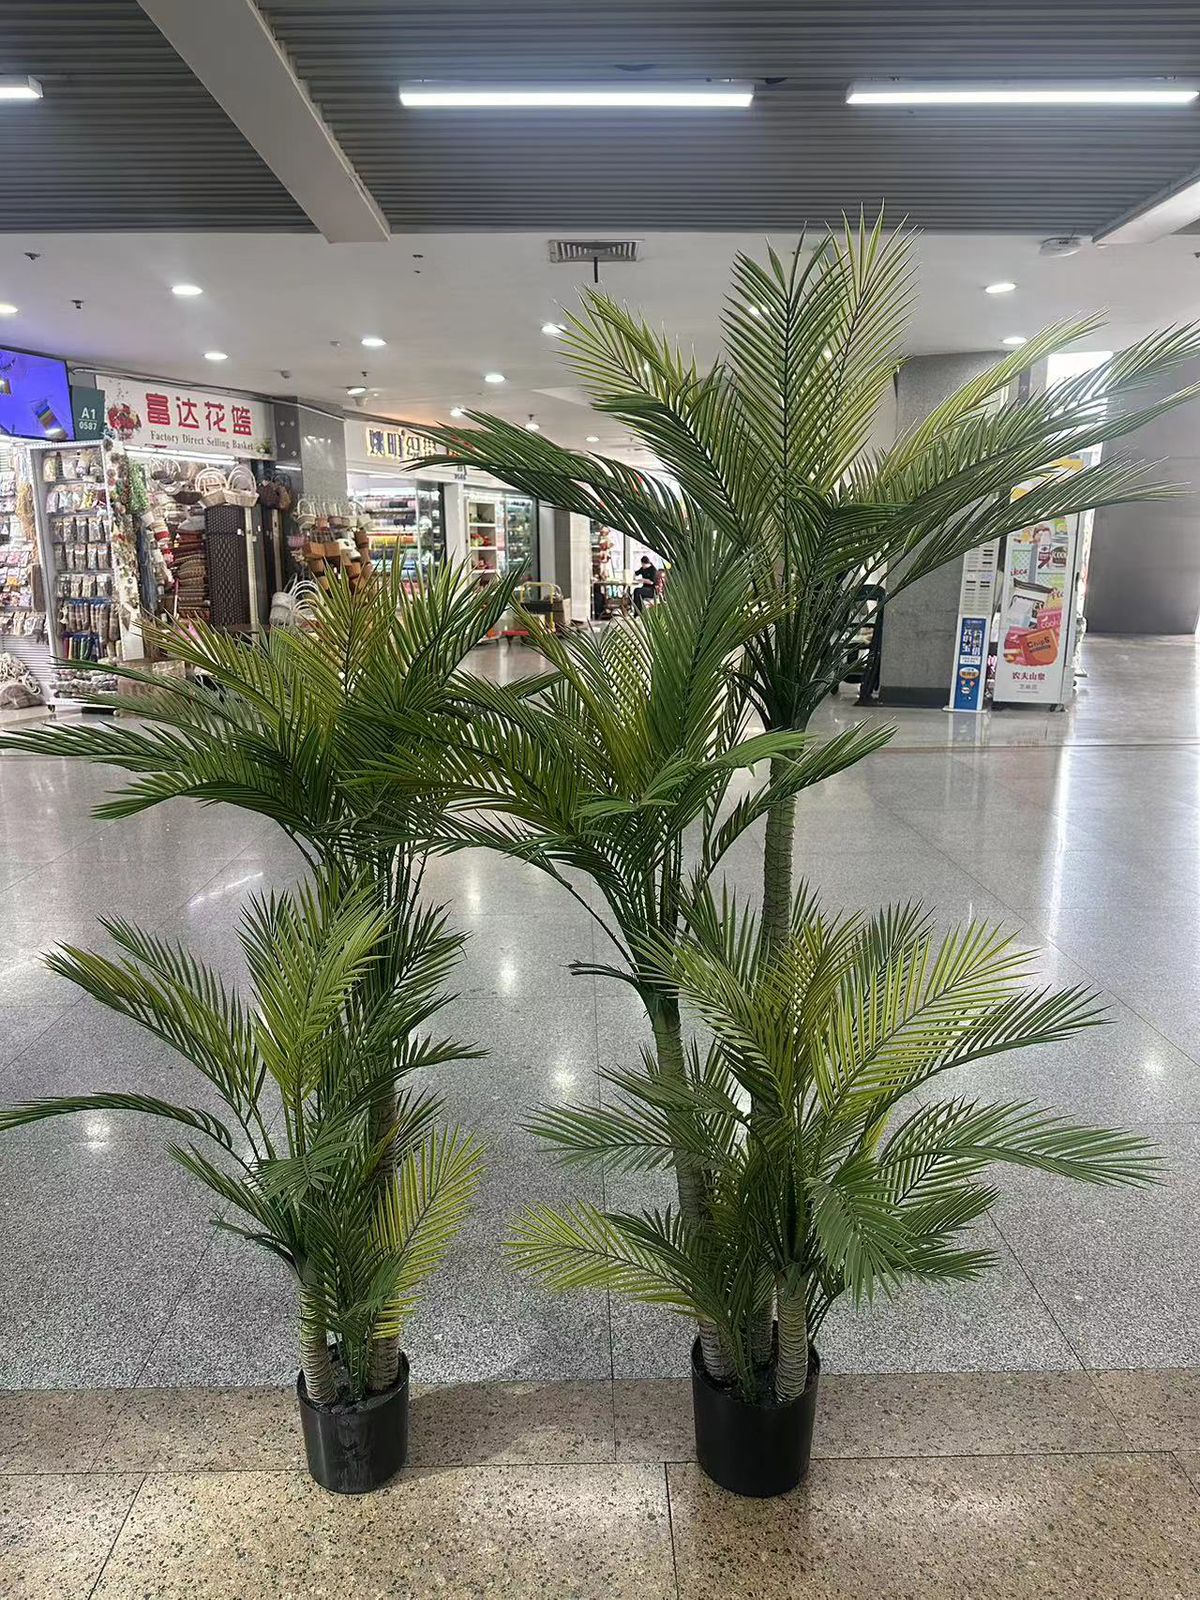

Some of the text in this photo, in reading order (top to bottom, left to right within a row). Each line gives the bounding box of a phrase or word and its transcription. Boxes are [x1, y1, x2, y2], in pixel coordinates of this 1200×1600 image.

[81, 407, 96, 420] A1
[146, 392, 252, 436] 富达花篮
[79, 421, 97, 431] 0587
[150, 430, 179, 444] Factory
[182, 433, 204, 445] Direct
[207, 436, 230, 449] Selling
